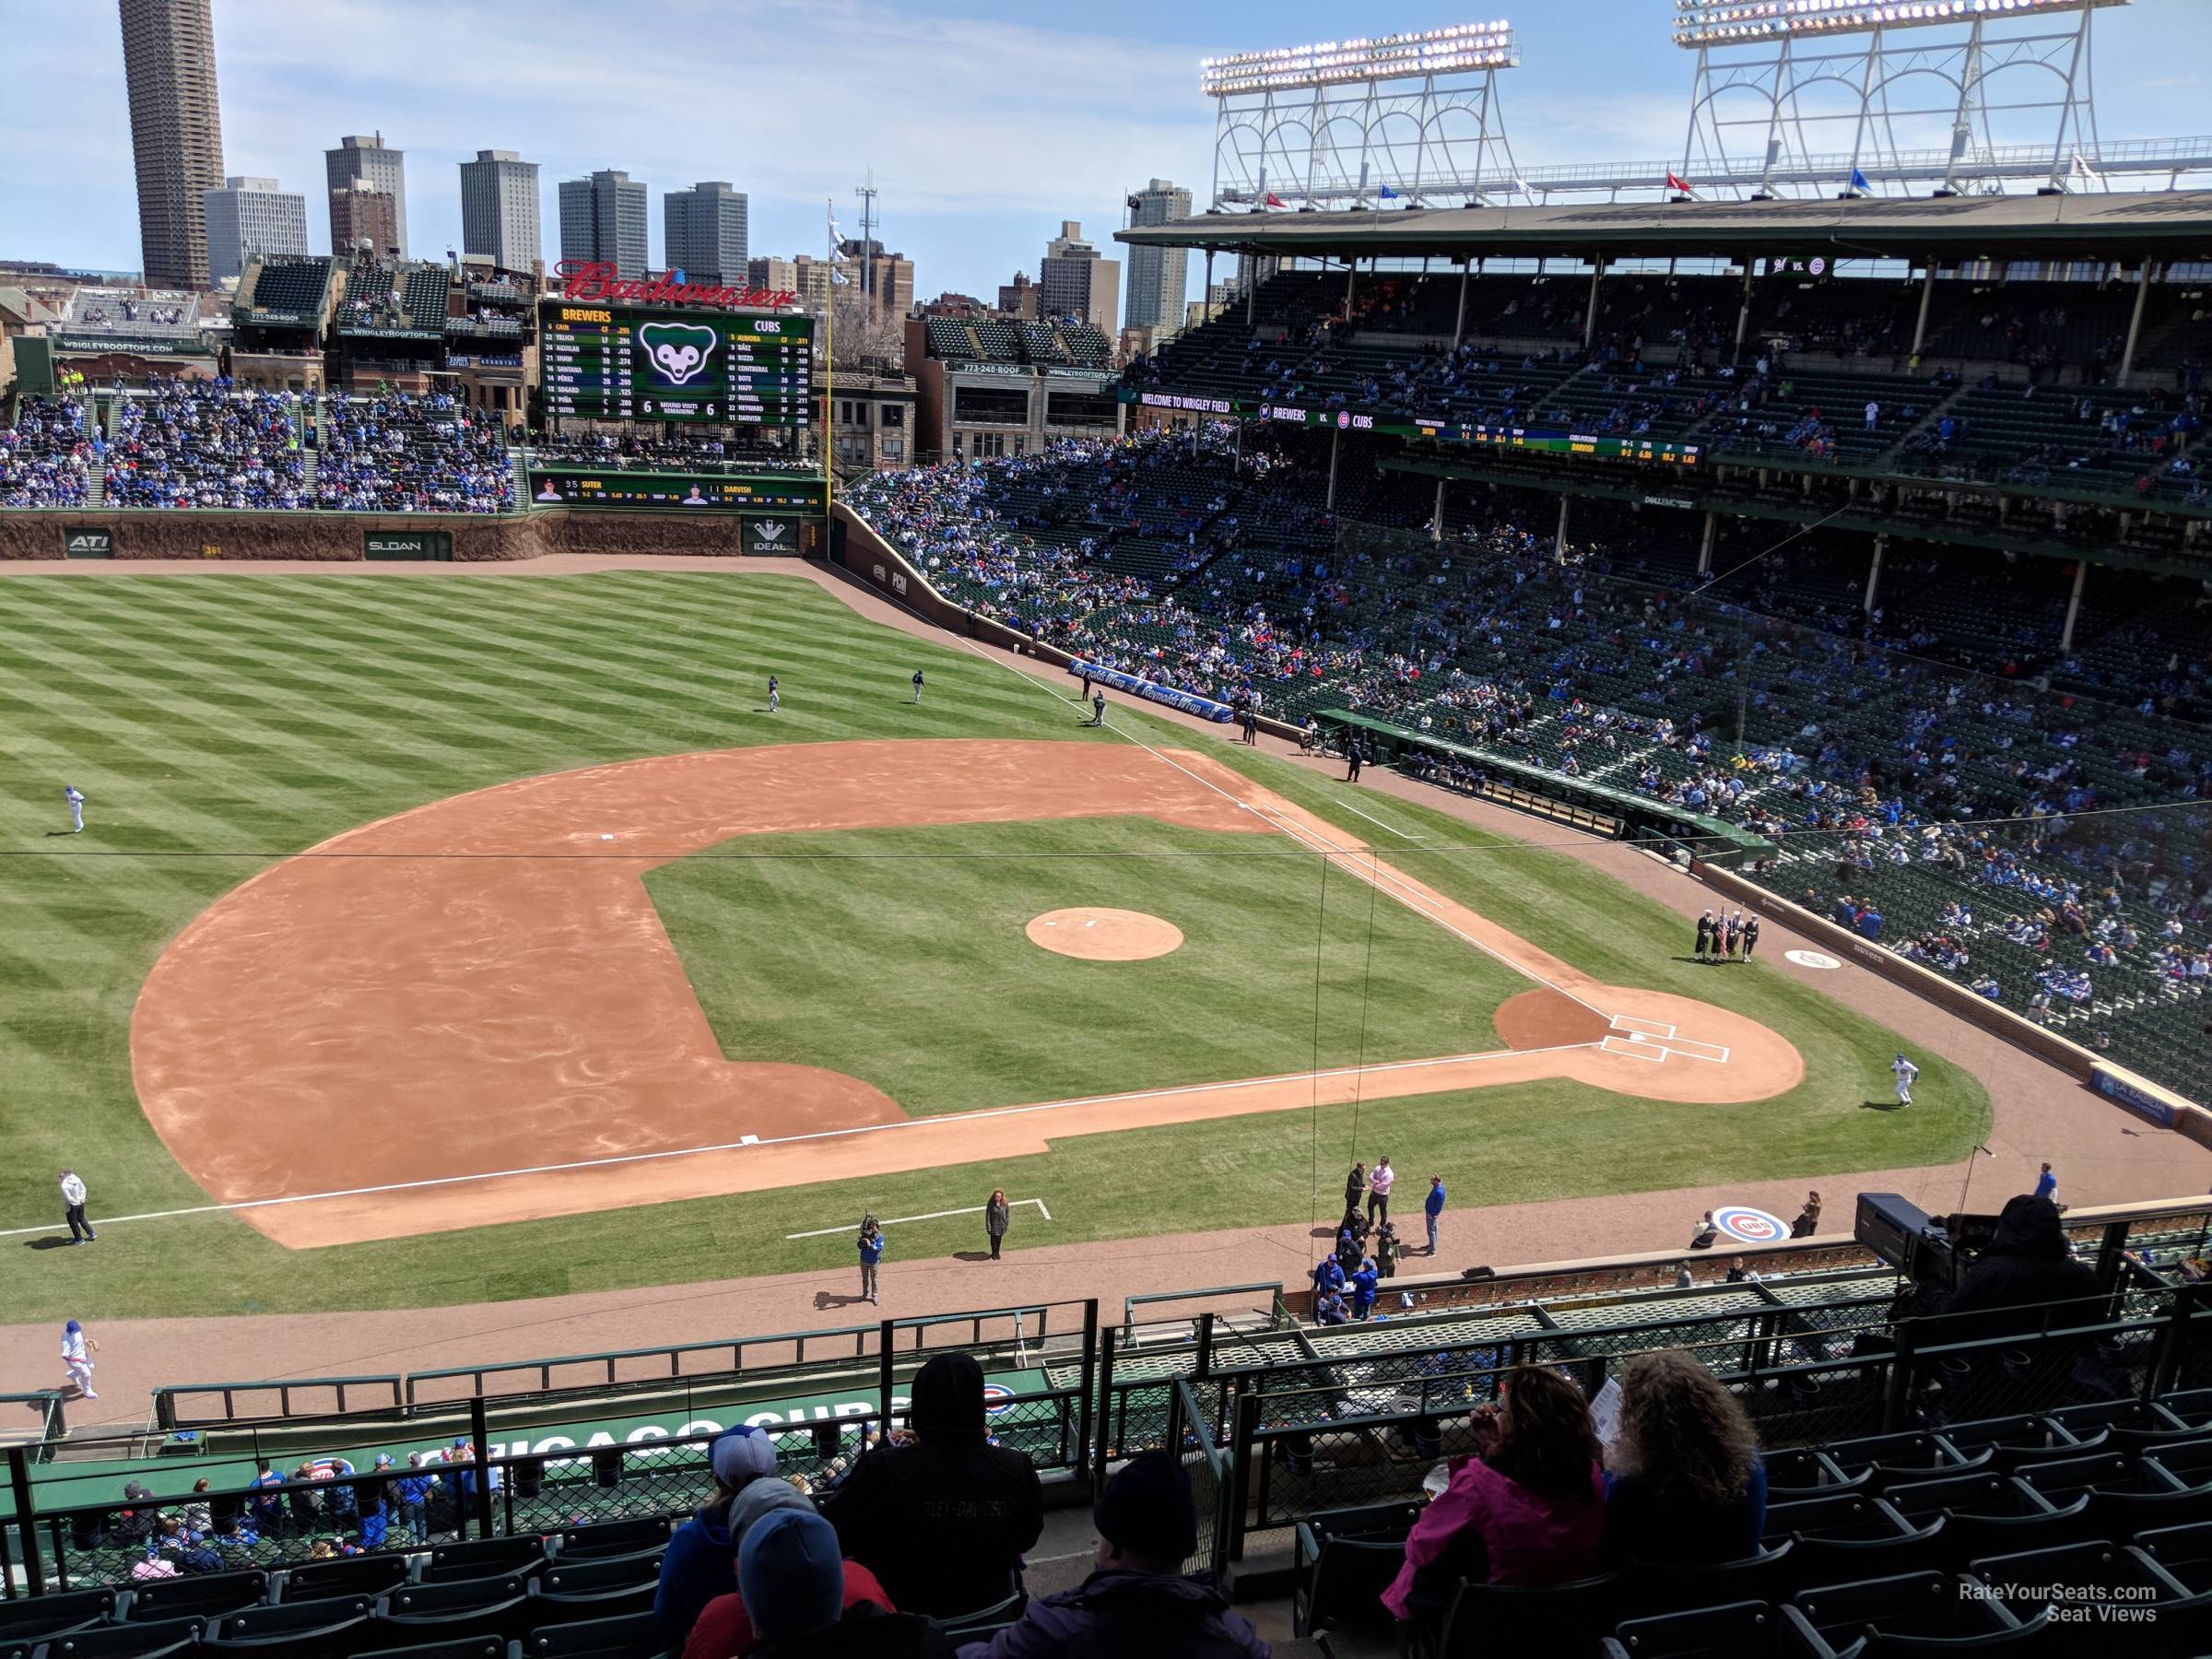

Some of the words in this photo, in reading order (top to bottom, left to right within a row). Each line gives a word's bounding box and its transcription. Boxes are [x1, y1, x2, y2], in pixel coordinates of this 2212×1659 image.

[554, 259, 800, 309] Budweiser
[562, 309, 611, 323] BREWERS
[556, 324, 570, 332] CAIN
[755, 320, 781, 333] CUBS
[64, 340, 173, 354] WRIGLEYROOFTOPS.COM
[556, 345, 581, 353] AGUILAR
[557, 366, 582, 374] SANTANA
[737, 365, 769, 373] CONTRERAS
[643, 400, 652, 413] 6
[706, 403, 715, 416] 6
[1142, 393, 1172, 407] WELCOME
[1172, 396, 1182, 407] TO
[1182, 397, 1211, 412] WRIGLEY
[1211, 400, 1230, 413] FIELD
[664, 407, 695, 416] REMAINING
[1273, 406, 1307, 422] BREWERS
[1319, 413, 1328, 422] VS.
[1352, 415, 1373, 429] CUBS
[1571, 443, 1594, 453] DARVISH
[581, 480, 602, 489] SUTER
[724, 486, 752, 494] DARVISH
[69, 535, 110, 547] ATI
[369, 541, 421, 551] SLOAN
[753, 542, 784, 551] IDEAL
[1105, 672, 1126, 688] Wrap
[1142, 685, 1180, 707] Reynolds
[1177, 696, 1202, 715] Wrap
